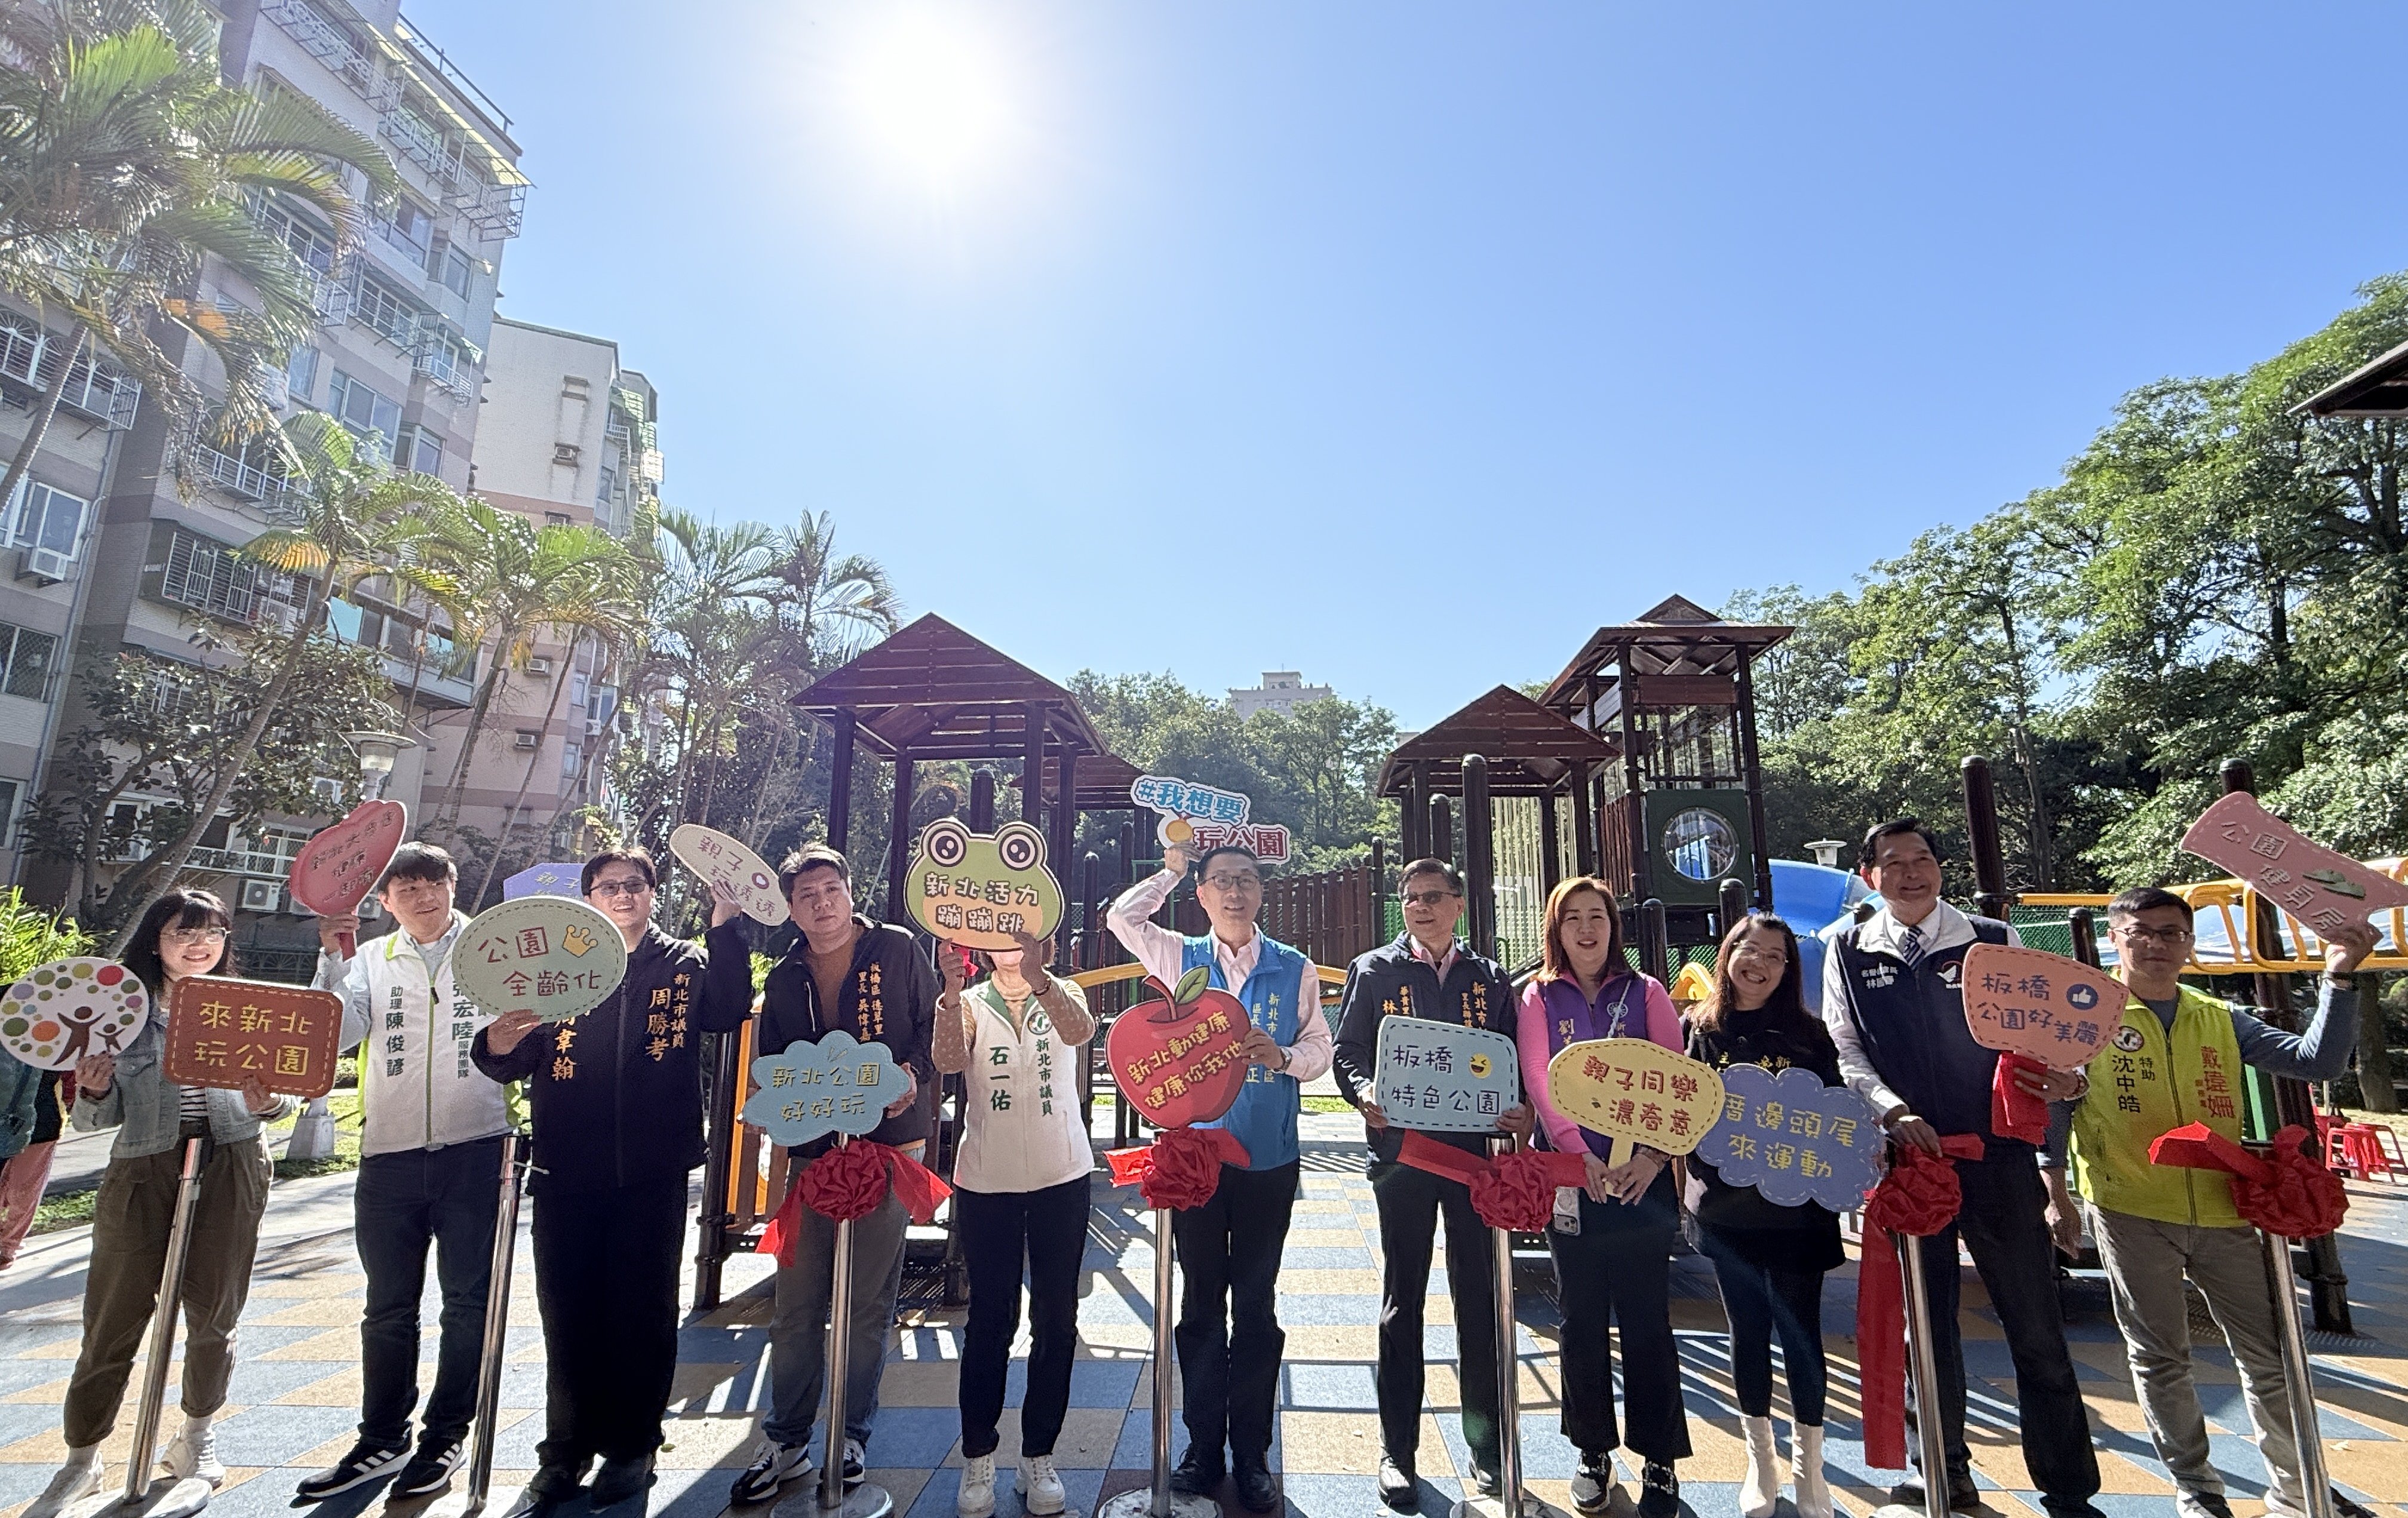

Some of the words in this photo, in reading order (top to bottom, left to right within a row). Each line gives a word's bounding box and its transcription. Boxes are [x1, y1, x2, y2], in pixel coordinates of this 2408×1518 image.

[1137, 781, 1243, 823] #我想要
[698, 835, 744, 871] 親子
[2221, 821, 2288, 860] 公園
[925, 871, 1039, 906] 新北活力
[2260, 864, 2347, 930] 健身房
[936, 904, 1024, 934] 蹦蹦跳
[477, 926, 549, 963] 公園
[502, 969, 602, 997] 全齡化
[1981, 973, 2050, 1001] 板橋
[199, 1001, 314, 1035] 來新北
[645, 987, 672, 1062] 周勝考
[670, 973, 691, 1049] 新北市議員
[1977, 1001, 2100, 1045] 公園好美麗
[194, 1041, 309, 1075] 玩公園
[1127, 1010, 1231, 1084] 新北動健康
[1393, 1044, 1453, 1074] 板橋
[773, 1063, 880, 1089] 新北公園
[989, 1046, 1012, 1111] 石一佑
[1036, 1038, 1053, 1117] 新北市議員
[1144, 1040, 1242, 1109] 健康你我他
[1582, 1055, 1698, 1102] 親子同樂
[2139, 1056, 2155, 1081] 特助
[781, 1093, 866, 1122] 好好玩
[1392, 1084, 1500, 1116] 特色公園
[1728, 1133, 1833, 1178] 來運動
